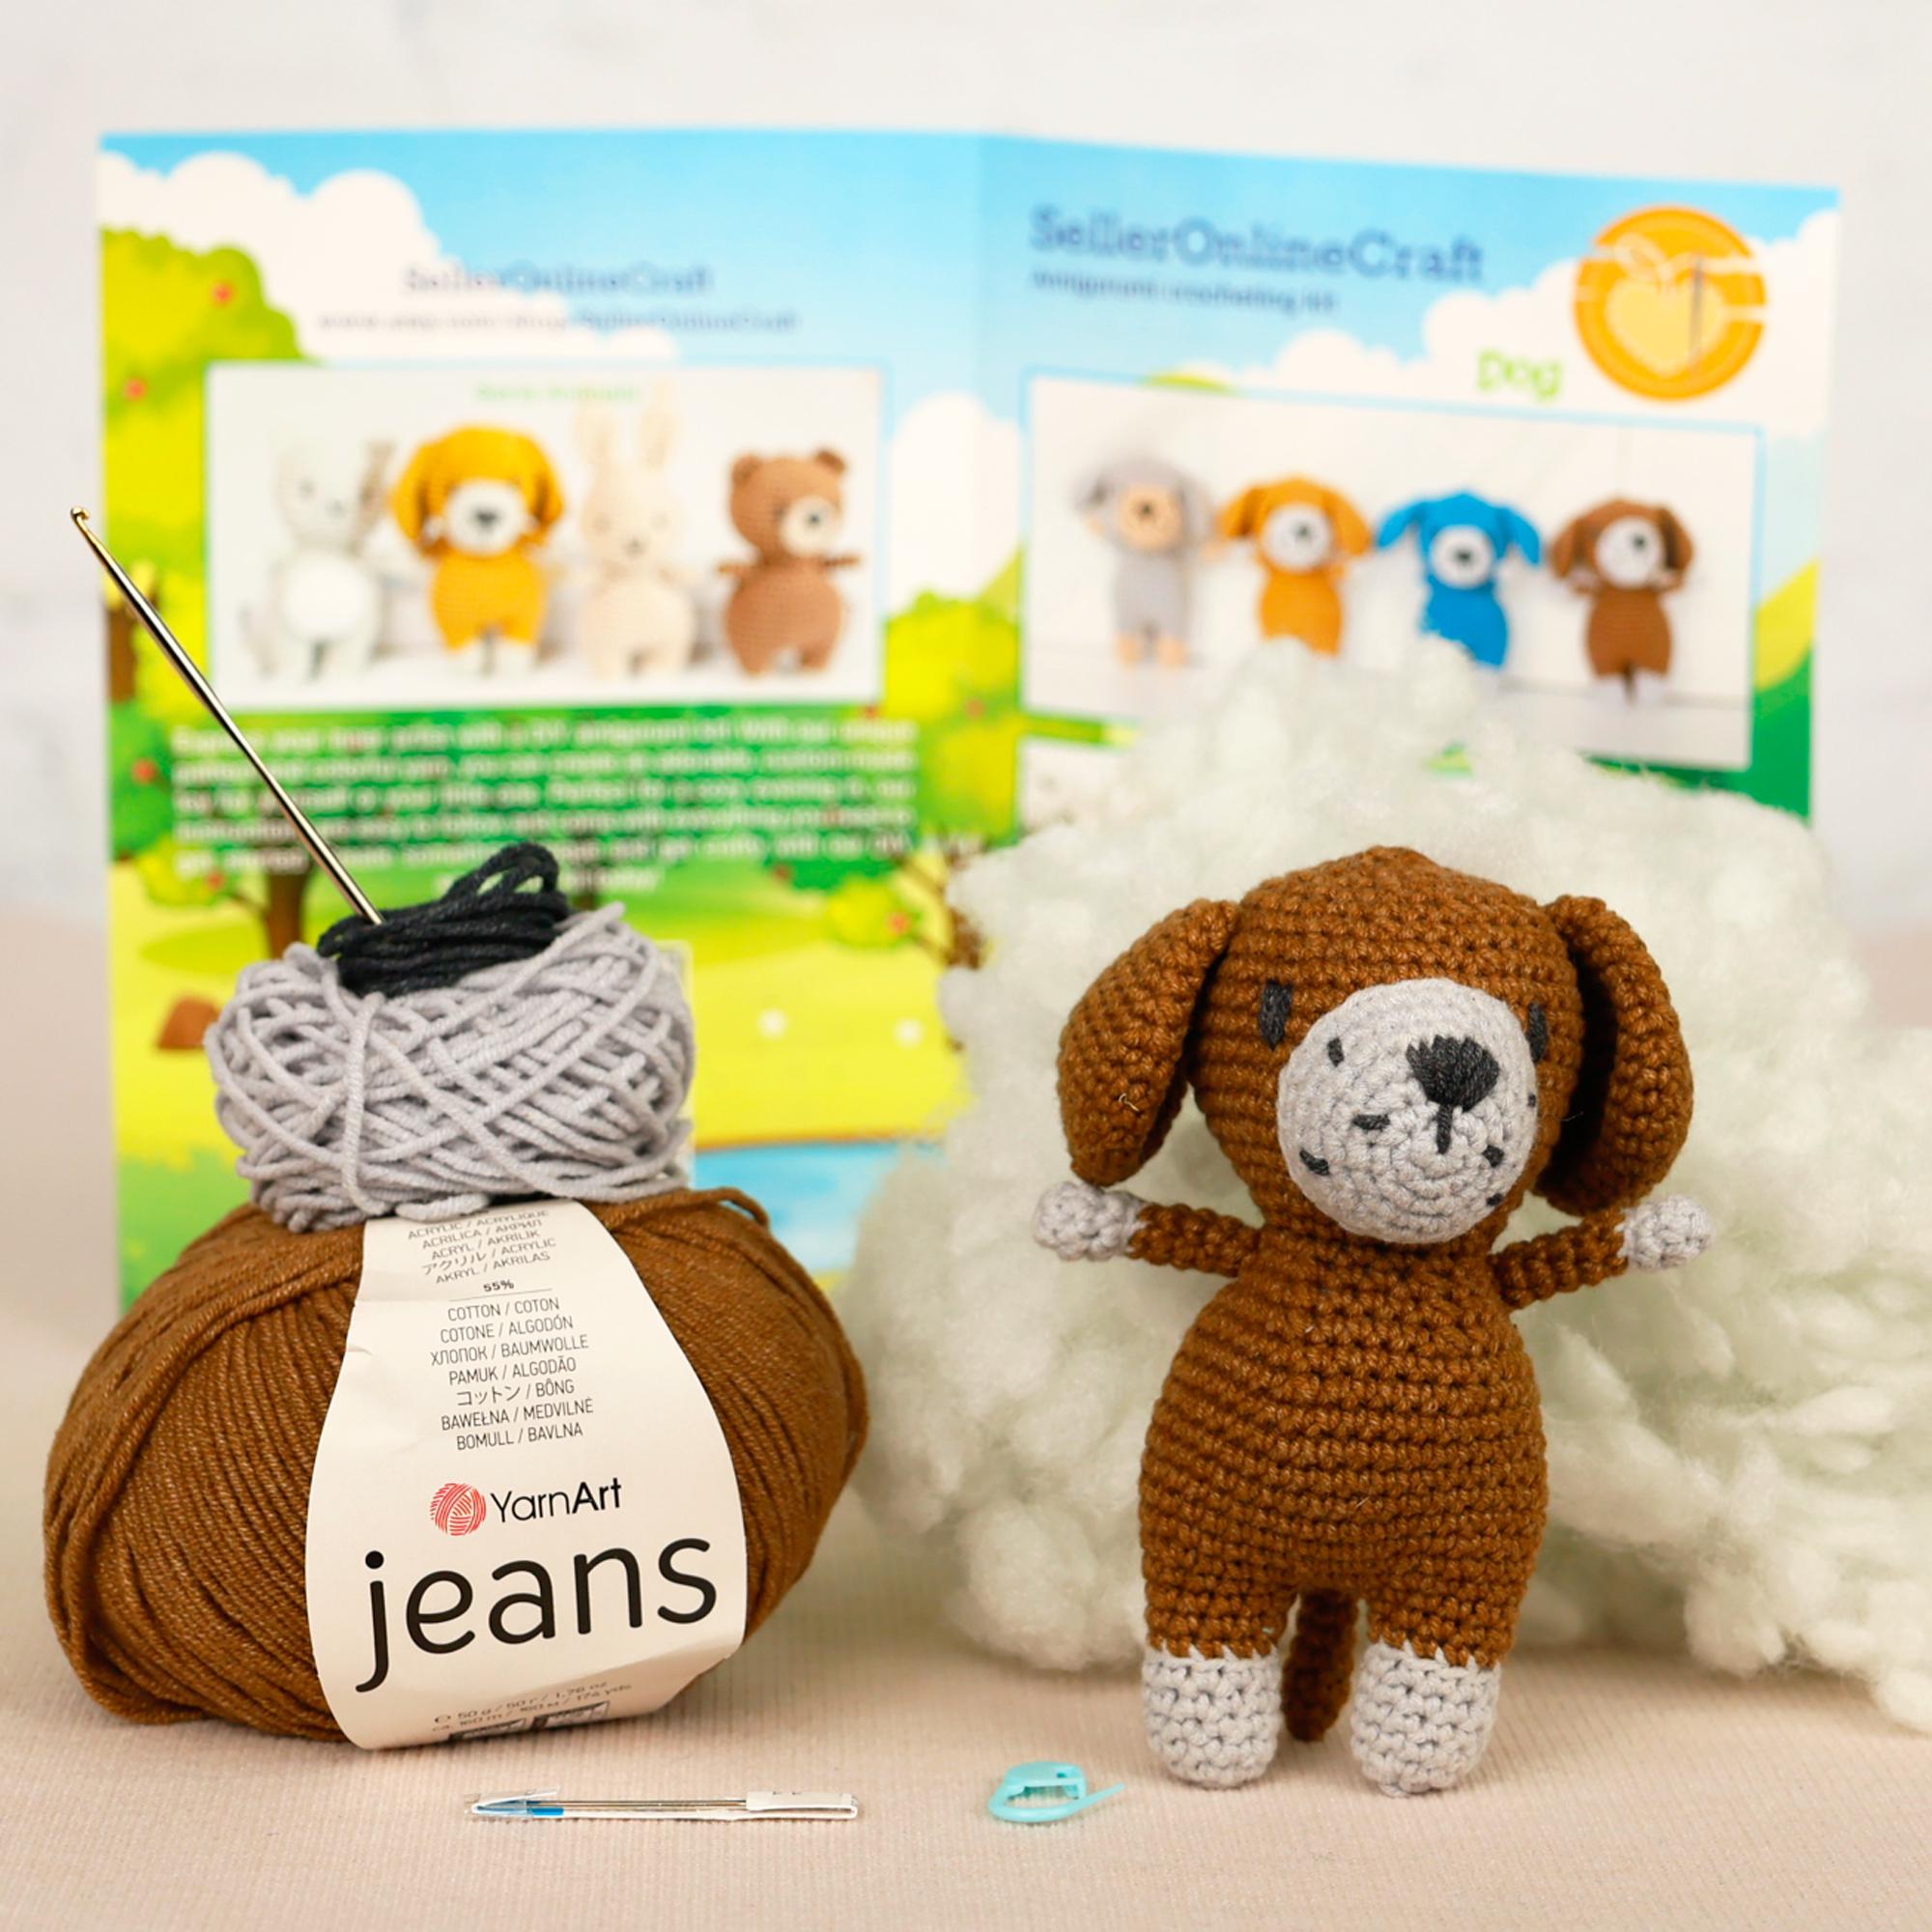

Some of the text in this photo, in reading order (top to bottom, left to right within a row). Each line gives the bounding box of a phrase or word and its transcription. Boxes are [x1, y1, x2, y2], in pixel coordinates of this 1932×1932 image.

[1031, 206, 1485, 283] SellerOnlineCraft
[1477, 349, 1563, 400] Dog
[408, 1221, 462, 1240] ACRYLIC
[422, 1230, 482, 1249] ACRILICA
[421, 1252, 487, 1275] アクリル
[500, 1237, 556, 1255] ACRYLIC
[431, 1243, 474, 1260] ACRYL
[436, 1267, 479, 1283] AKRYL
[493, 1251, 551, 1269] AKRILAS
[483, 1279, 515, 1293] 55%
[447, 1304, 501, 1321] COTTON
[514, 1297, 560, 1314] COTON
[440, 1323, 495, 1343] COTONE
[508, 1315, 574, 1336] ALGODÓN
[431, 1346, 487, 1366] ХЛОПОК
[500, 1334, 589, 1358] BAUMWOLLE
[448, 1366, 498, 1385] PAMUK
[512, 1356, 578, 1378] ALGODÃO
[456, 1385, 521, 1406] コットン
[535, 1378, 575, 1398] BÔNG
[440, 1408, 510, 1432] BAWEŁNA
[456, 1430, 514, 1451] BOMULL
[527, 1422, 583, 1442] BAVLNA
[491, 1477, 623, 1523] YarnArt
[355, 1538, 718, 1692] jeans
